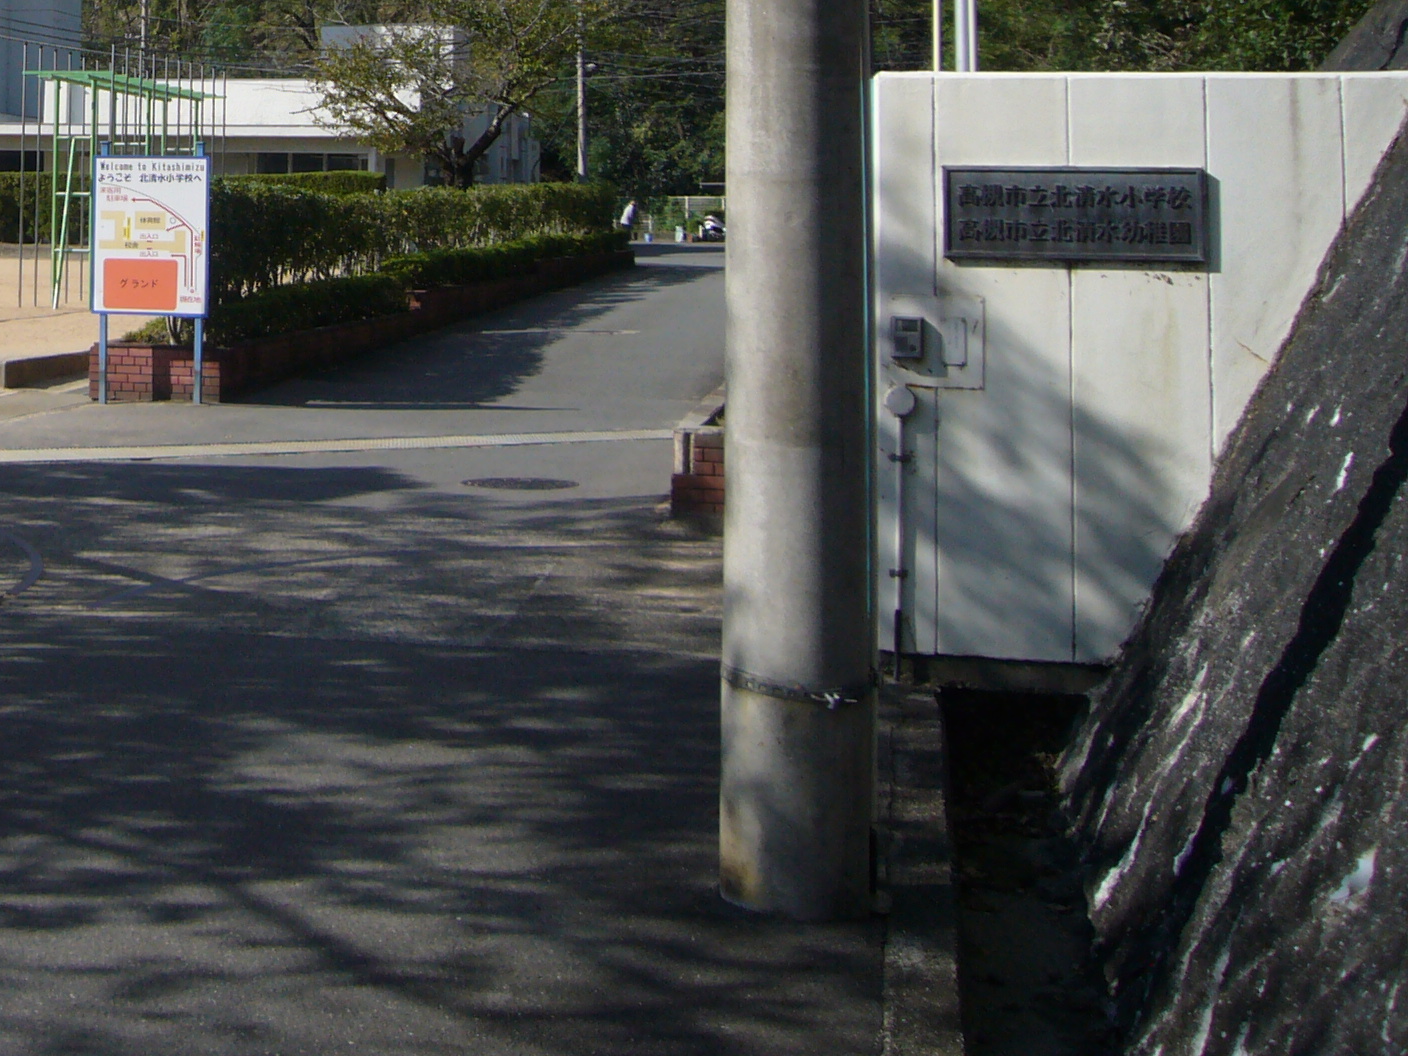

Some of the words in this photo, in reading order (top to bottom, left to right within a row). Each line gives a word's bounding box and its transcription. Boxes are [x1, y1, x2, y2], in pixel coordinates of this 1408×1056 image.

[100, 161, 133, 171] Welcome
[138, 162, 146, 171] to
[152, 162, 205, 171] Kitashimizu
[98, 173, 131, 183] ようこそ
[139, 173, 202, 183] 北清水小学校へ
[957, 184, 1193, 209] 高槻市立北清水小学校
[957, 218, 1192, 244] 高槻市立北清水幼稚園
[120, 279, 158, 288] グランド
